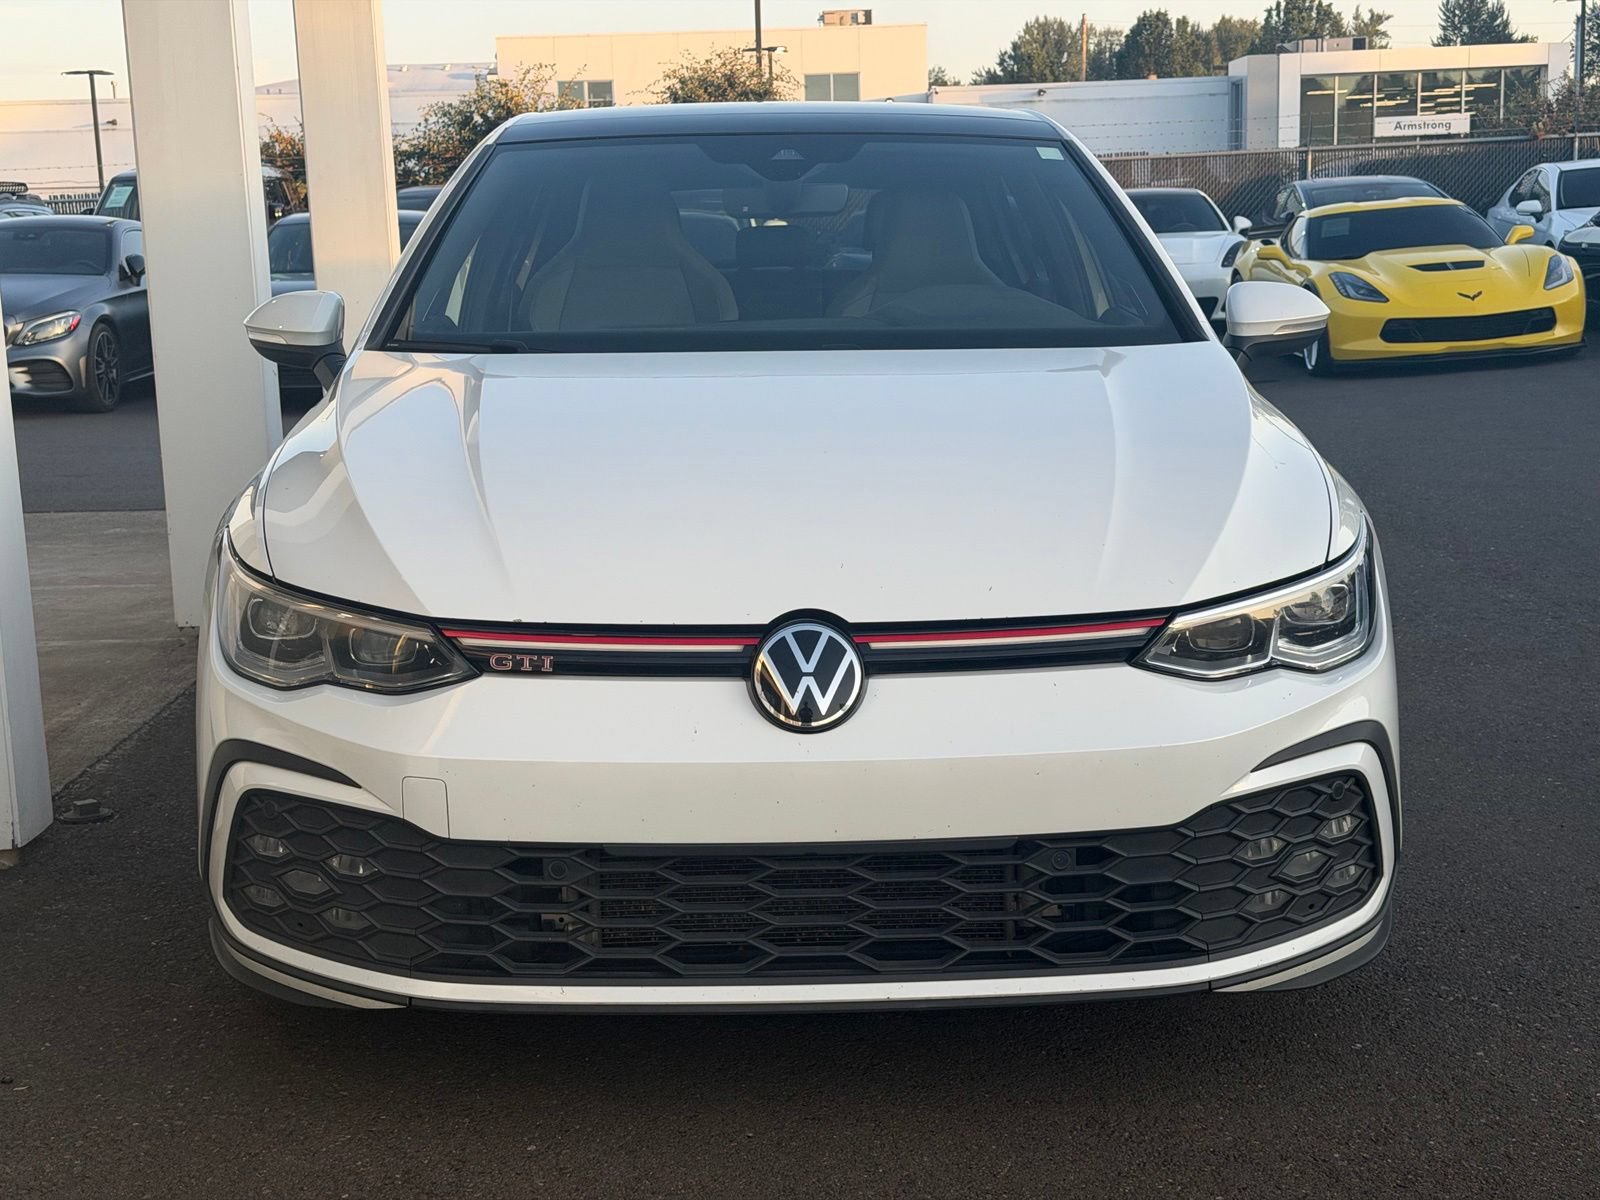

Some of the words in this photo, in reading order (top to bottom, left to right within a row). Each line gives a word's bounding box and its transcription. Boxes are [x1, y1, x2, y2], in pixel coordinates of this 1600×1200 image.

[1393, 121, 1452, 131] Armstrong
[489, 653, 554, 672] GTI
[757, 625, 858, 718] VW
